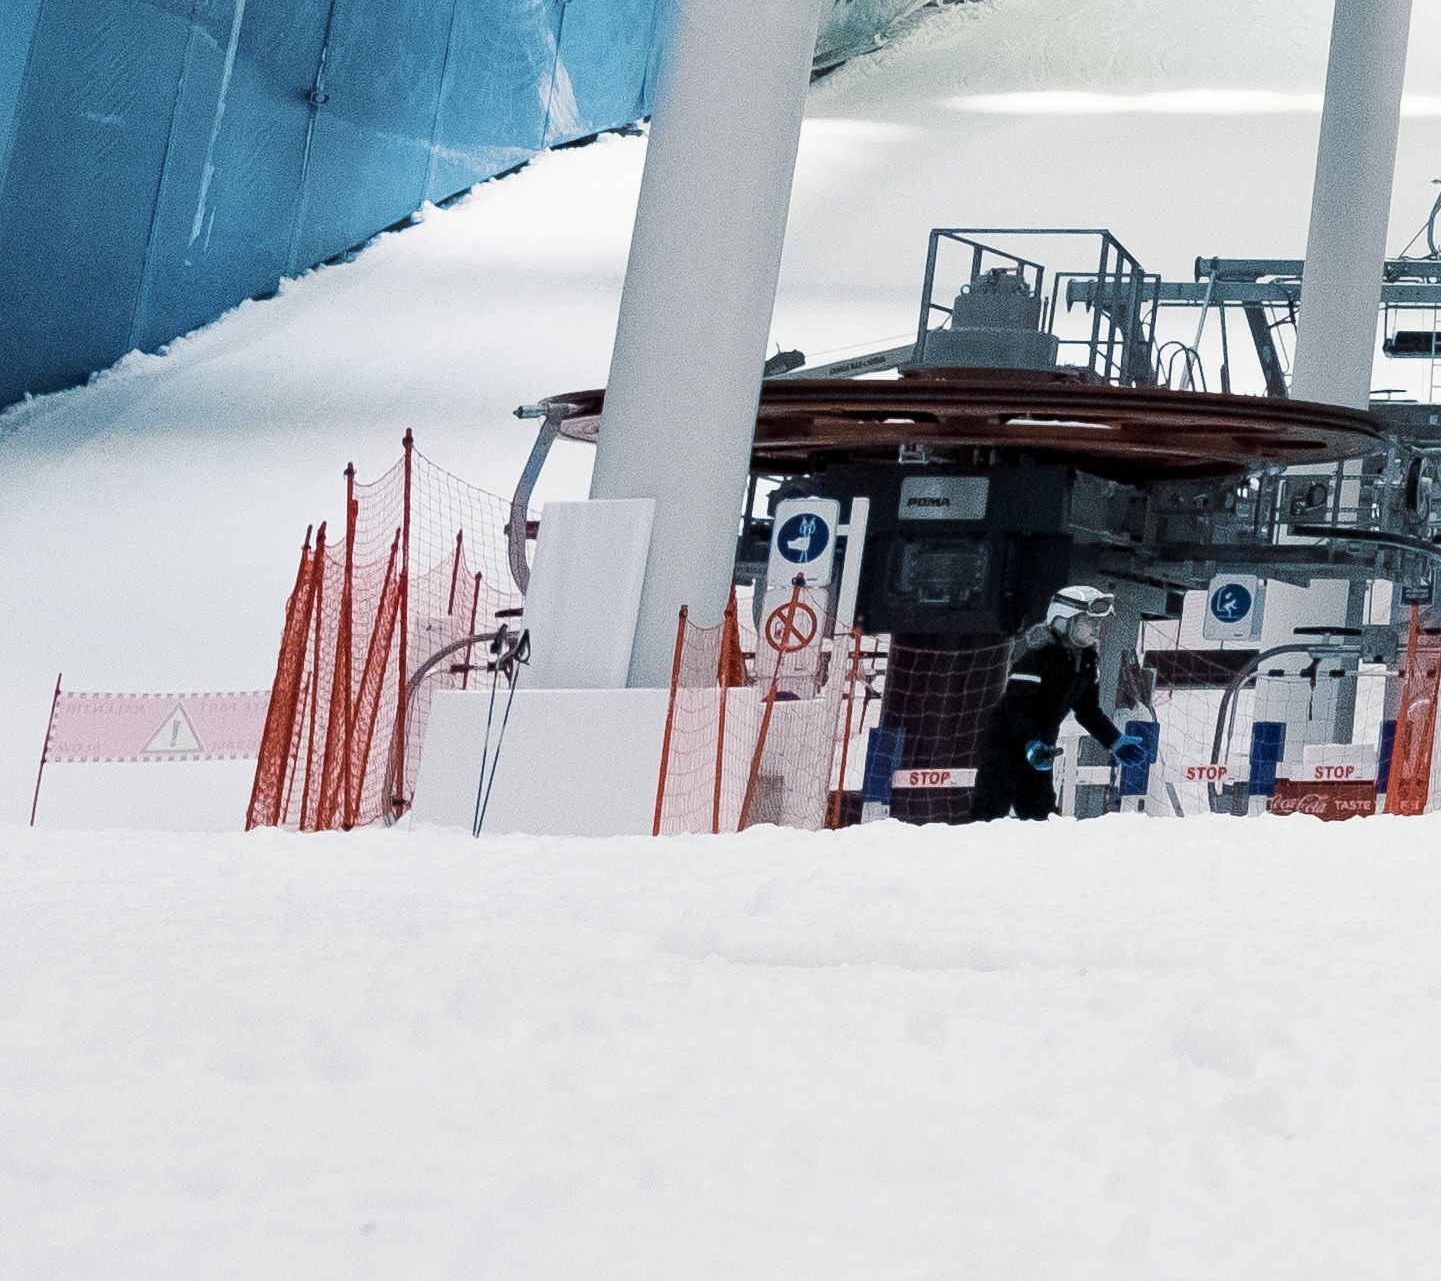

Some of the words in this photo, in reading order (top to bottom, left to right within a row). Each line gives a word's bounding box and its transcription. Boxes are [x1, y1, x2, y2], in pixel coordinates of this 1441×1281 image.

[907, 497, 950, 508] POMA
[909, 771, 950, 786] STOP
[1186, 766, 1228, 780] STOP
[1314, 765, 1355, 779] STOP
[1270, 793, 1330, 814] Coca-Cola
[1334, 800, 1372, 811] TASTE
